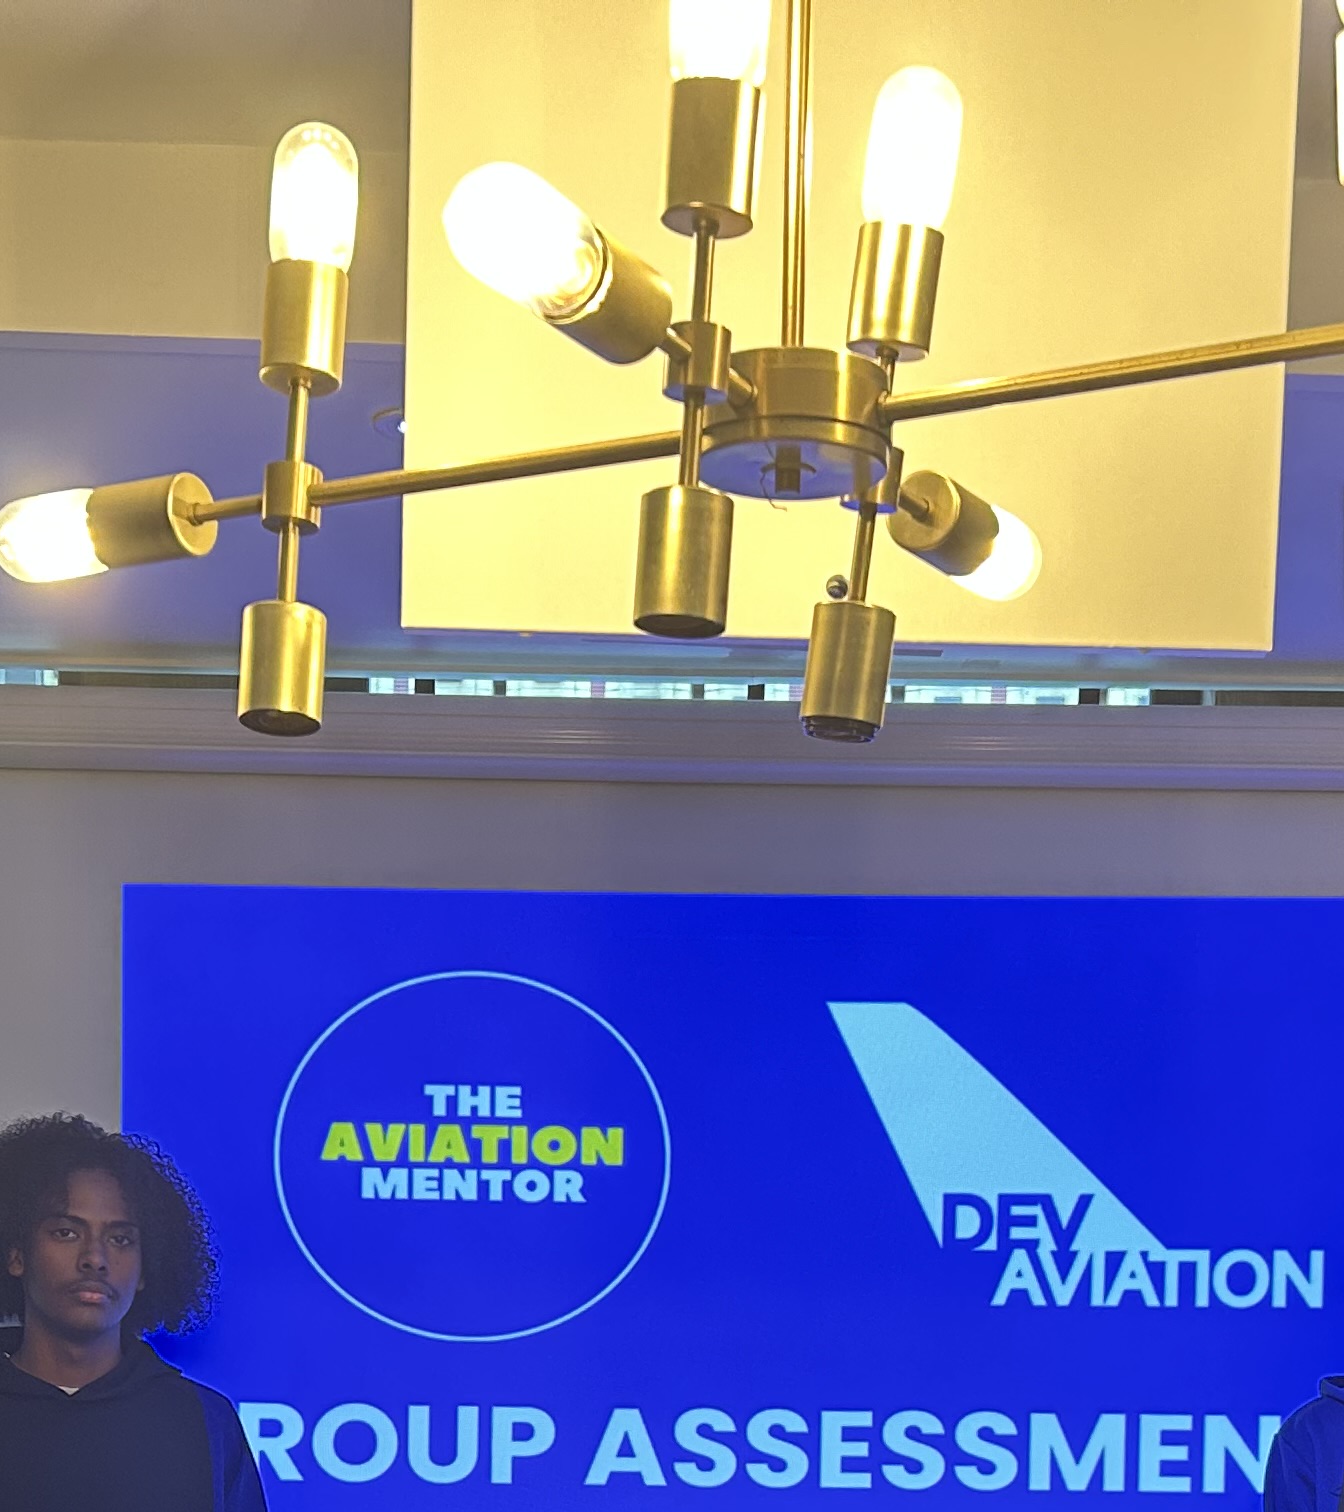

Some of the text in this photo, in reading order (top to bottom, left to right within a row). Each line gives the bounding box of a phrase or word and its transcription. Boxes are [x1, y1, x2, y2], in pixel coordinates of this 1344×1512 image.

[423, 1083, 523, 1119] THE
[319, 1121, 625, 1167] AVIATION
[360, 1166, 588, 1204] MENTOR
[941, 1192, 1096, 1252] DEV
[989, 1247, 1326, 1310] AVIATION
[232, 1401, 1283, 1495] ROUP ASSESSMEN
